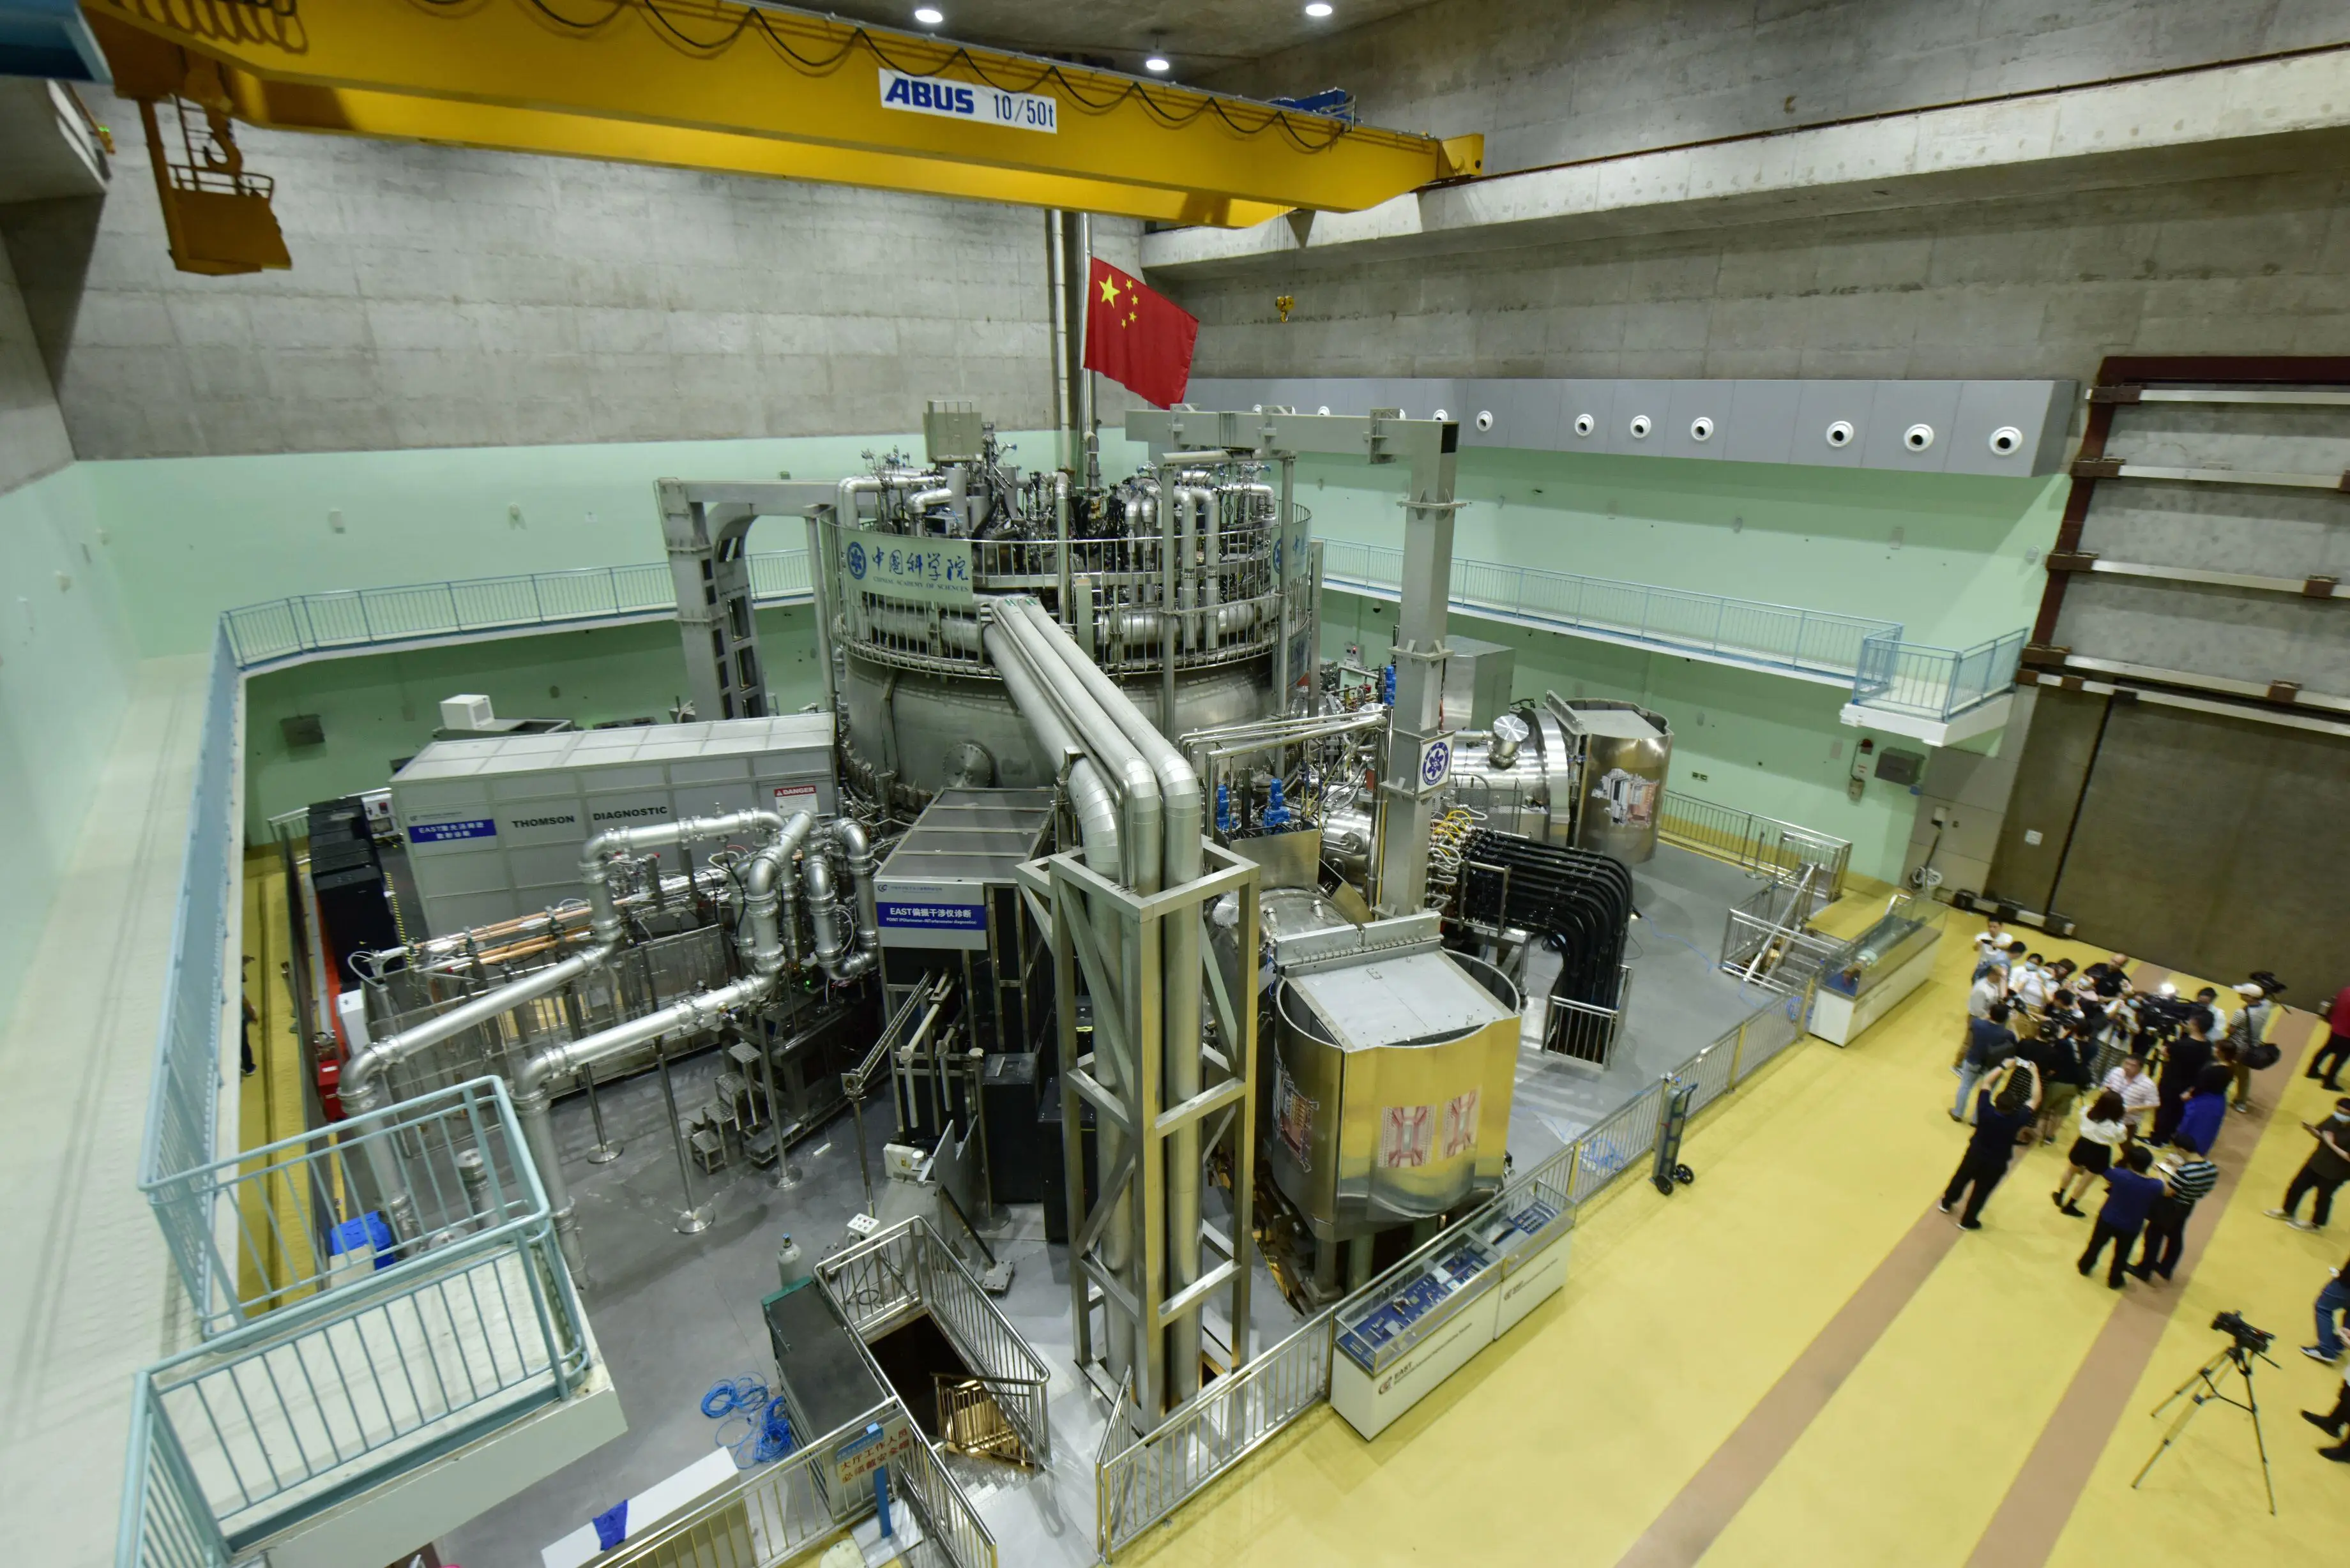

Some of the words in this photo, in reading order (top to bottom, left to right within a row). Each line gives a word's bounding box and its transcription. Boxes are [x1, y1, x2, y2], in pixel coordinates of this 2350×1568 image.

[884, 77, 974, 114] ABUS
[994, 94, 1054, 128] 10/50t
[872, 546, 969, 581] 中国科学院
[873, 576, 894, 584] CHINESE
[897, 580, 923, 588] ACADEMY
[783, 787, 815, 795] DANGER
[512, 815, 575, 828] THOMSON
[593, 806, 668, 821] DIAGNOSTIC
[890, 907, 971, 918] EAST偏振干涉仪诊断
